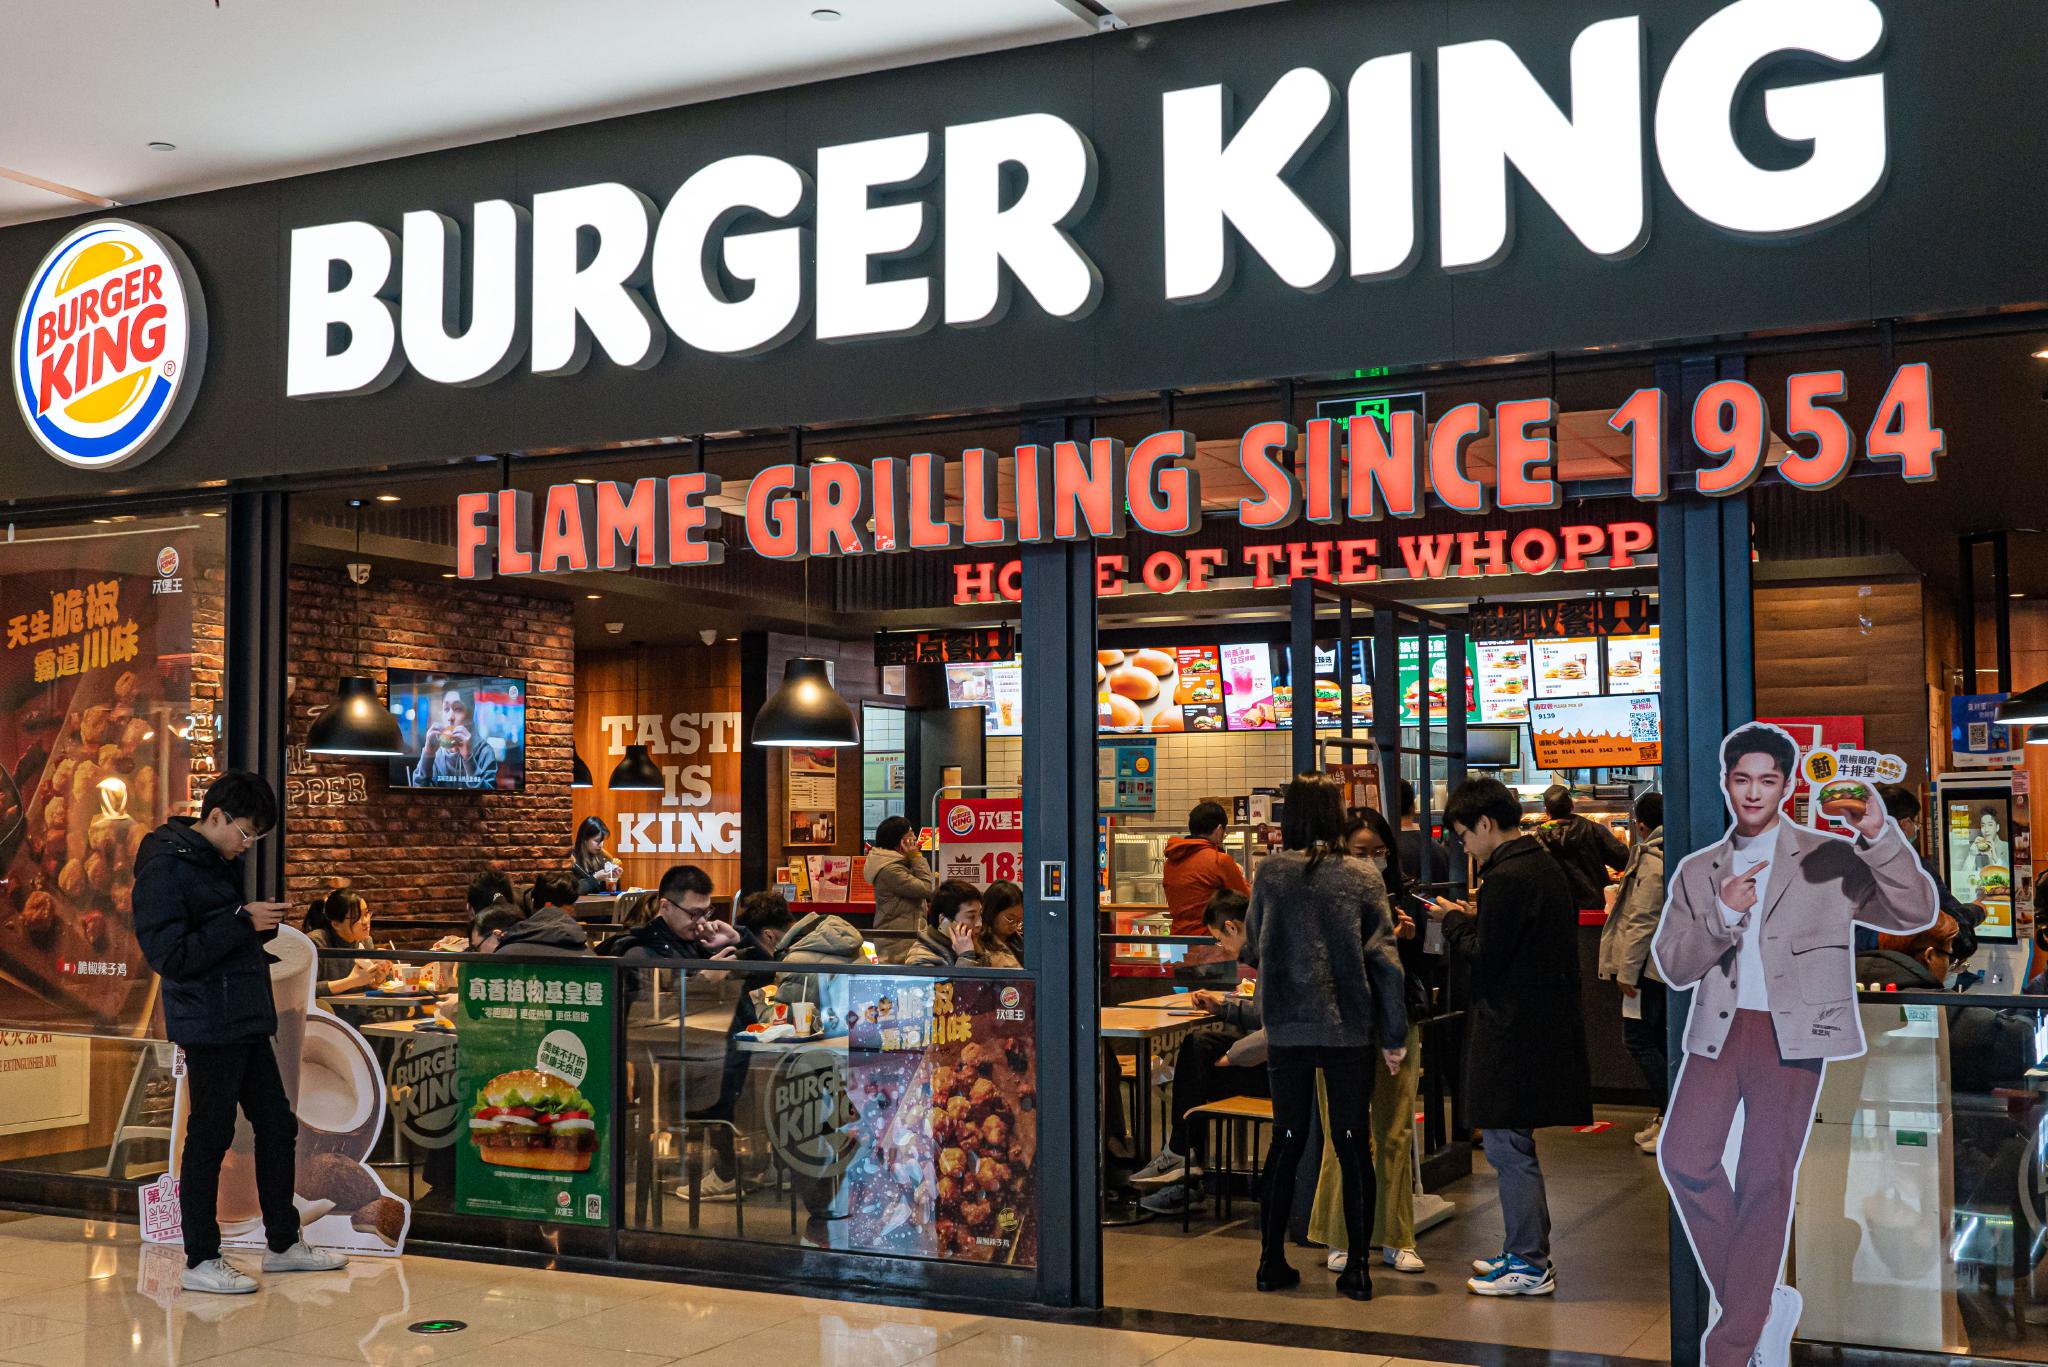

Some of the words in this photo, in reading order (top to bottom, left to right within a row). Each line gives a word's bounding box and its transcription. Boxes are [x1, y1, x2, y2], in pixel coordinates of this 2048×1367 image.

[287, 114, 1093, 396] BURGER
[1162, 0, 1887, 298] KING
[37, 264, 163, 357] BURGER
[39, 303, 167, 414] KING
[456, 473, 710, 579] FLAME
[745, 430, 1189, 561] GRILLING
[1240, 398, 1554, 528] SINCE
[1609, 363, 1944, 499] 1954
[952, 555, 1124, 605] HOE
[1142, 548, 1223, 593] OF
[1243, 538, 1378, 589] THE
[1397, 521, 1655, 580] WHOPP
[152, 577, 183, 595] 汉堡王
[7, 579, 119, 650] 天生脆椒
[34, 617, 139, 683] 霸道川味
[601, 712, 741, 755] TAST
[1838, 764, 1876, 778] 牛排堡
[1839, 754, 1877, 766] 黑椒眼肉
[661, 764, 712, 807] IS
[617, 811, 741, 855] KING
[952, 817, 972, 829] KING
[980, 851, 1016, 884] 18
[77, 961, 127, 976] 脆椒辣子鸡
[469, 977, 603, 1006] 真香植物基皇堡
[996, 1009, 1025, 1021] 汉堡王
[540, 1052, 583, 1079] 健康无负担
[543, 1041, 586, 1068] 美味不打折
